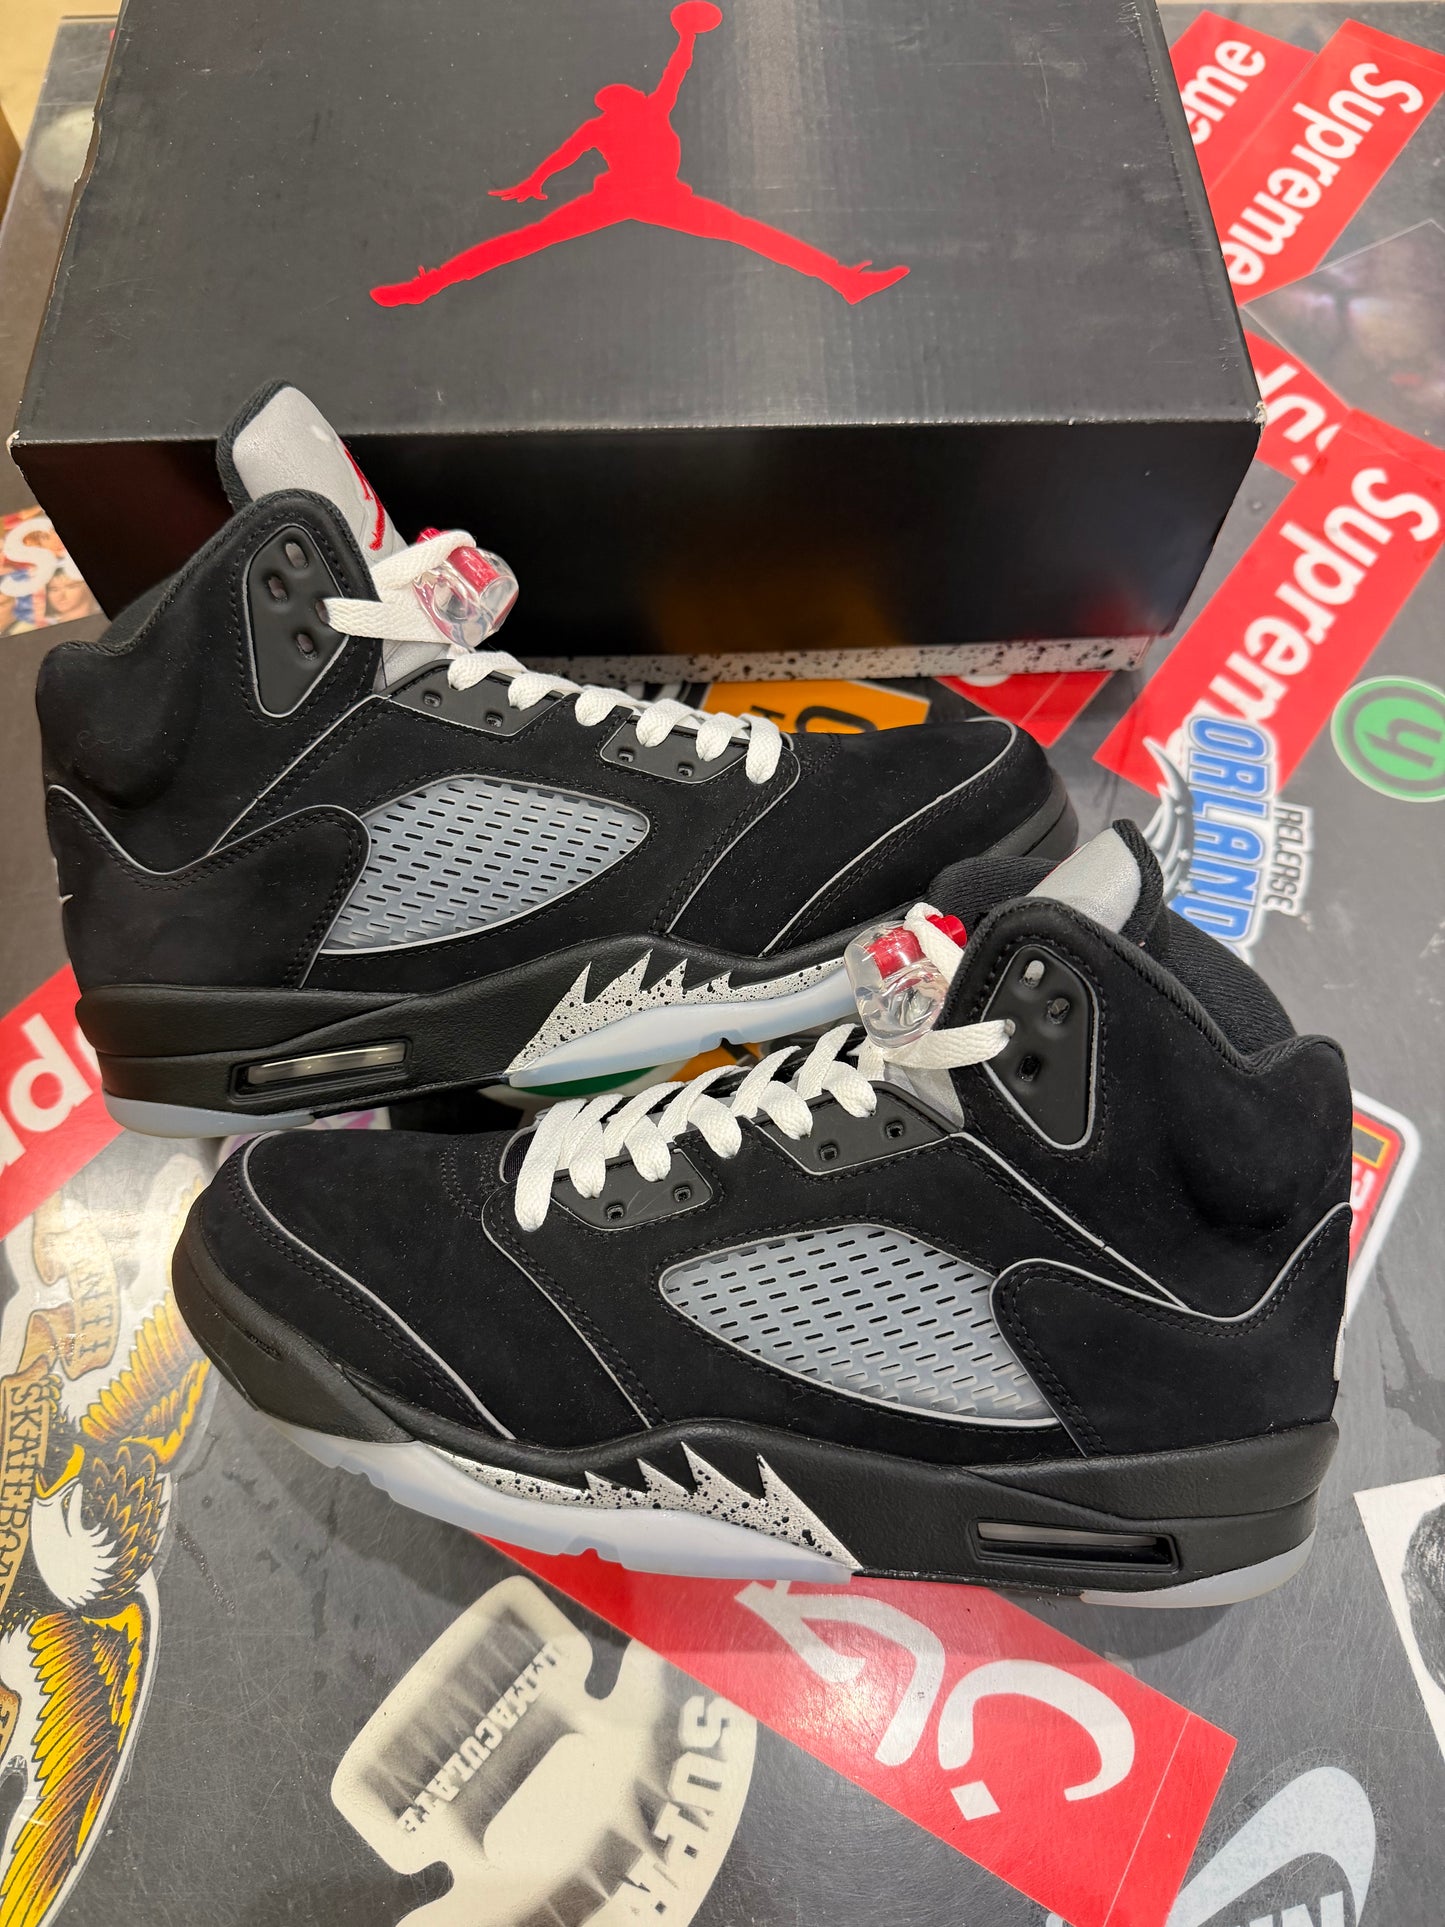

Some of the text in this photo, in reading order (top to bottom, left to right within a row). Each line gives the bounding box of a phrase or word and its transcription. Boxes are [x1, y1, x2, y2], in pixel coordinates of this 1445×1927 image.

[1222, 62, 1424, 285] Supreme
[1166, 468, 1440, 767] Suprem
[1169, 714, 1271, 963] ORLAND
[76, 1257, 113, 1358] NTI
[0, 1383, 47, 1590] SKATEBO
[396, 1643, 561, 1834] IMMACULATE
[582, 1696, 730, 1927] SUPR
